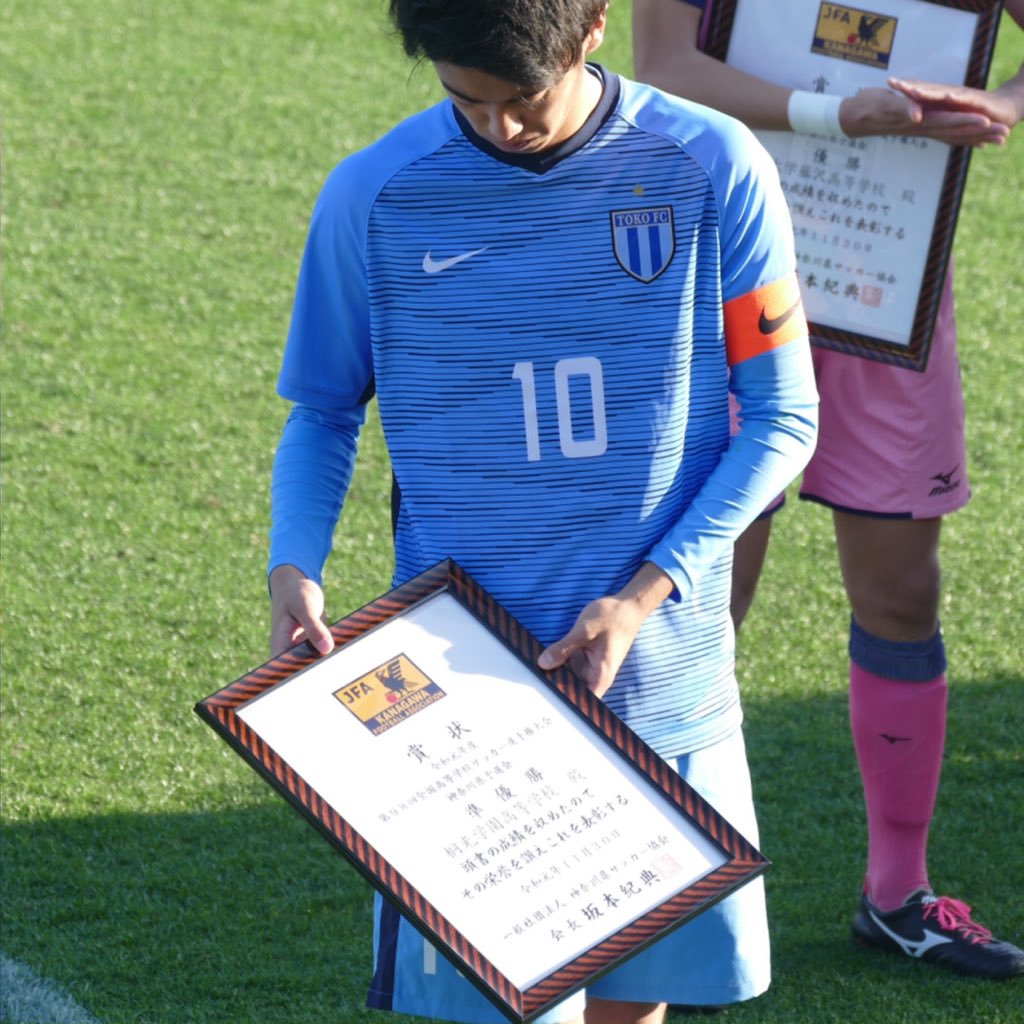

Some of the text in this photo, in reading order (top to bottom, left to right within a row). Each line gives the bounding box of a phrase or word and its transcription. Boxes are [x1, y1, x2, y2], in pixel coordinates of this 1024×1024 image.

[823, 6, 851, 24] JFA
[617, 211, 667, 226] TOKO FC
[512, 356, 608, 462] 10
[342, 681, 375, 705] JFA
[375, 689, 431, 724] KANAGAWA
